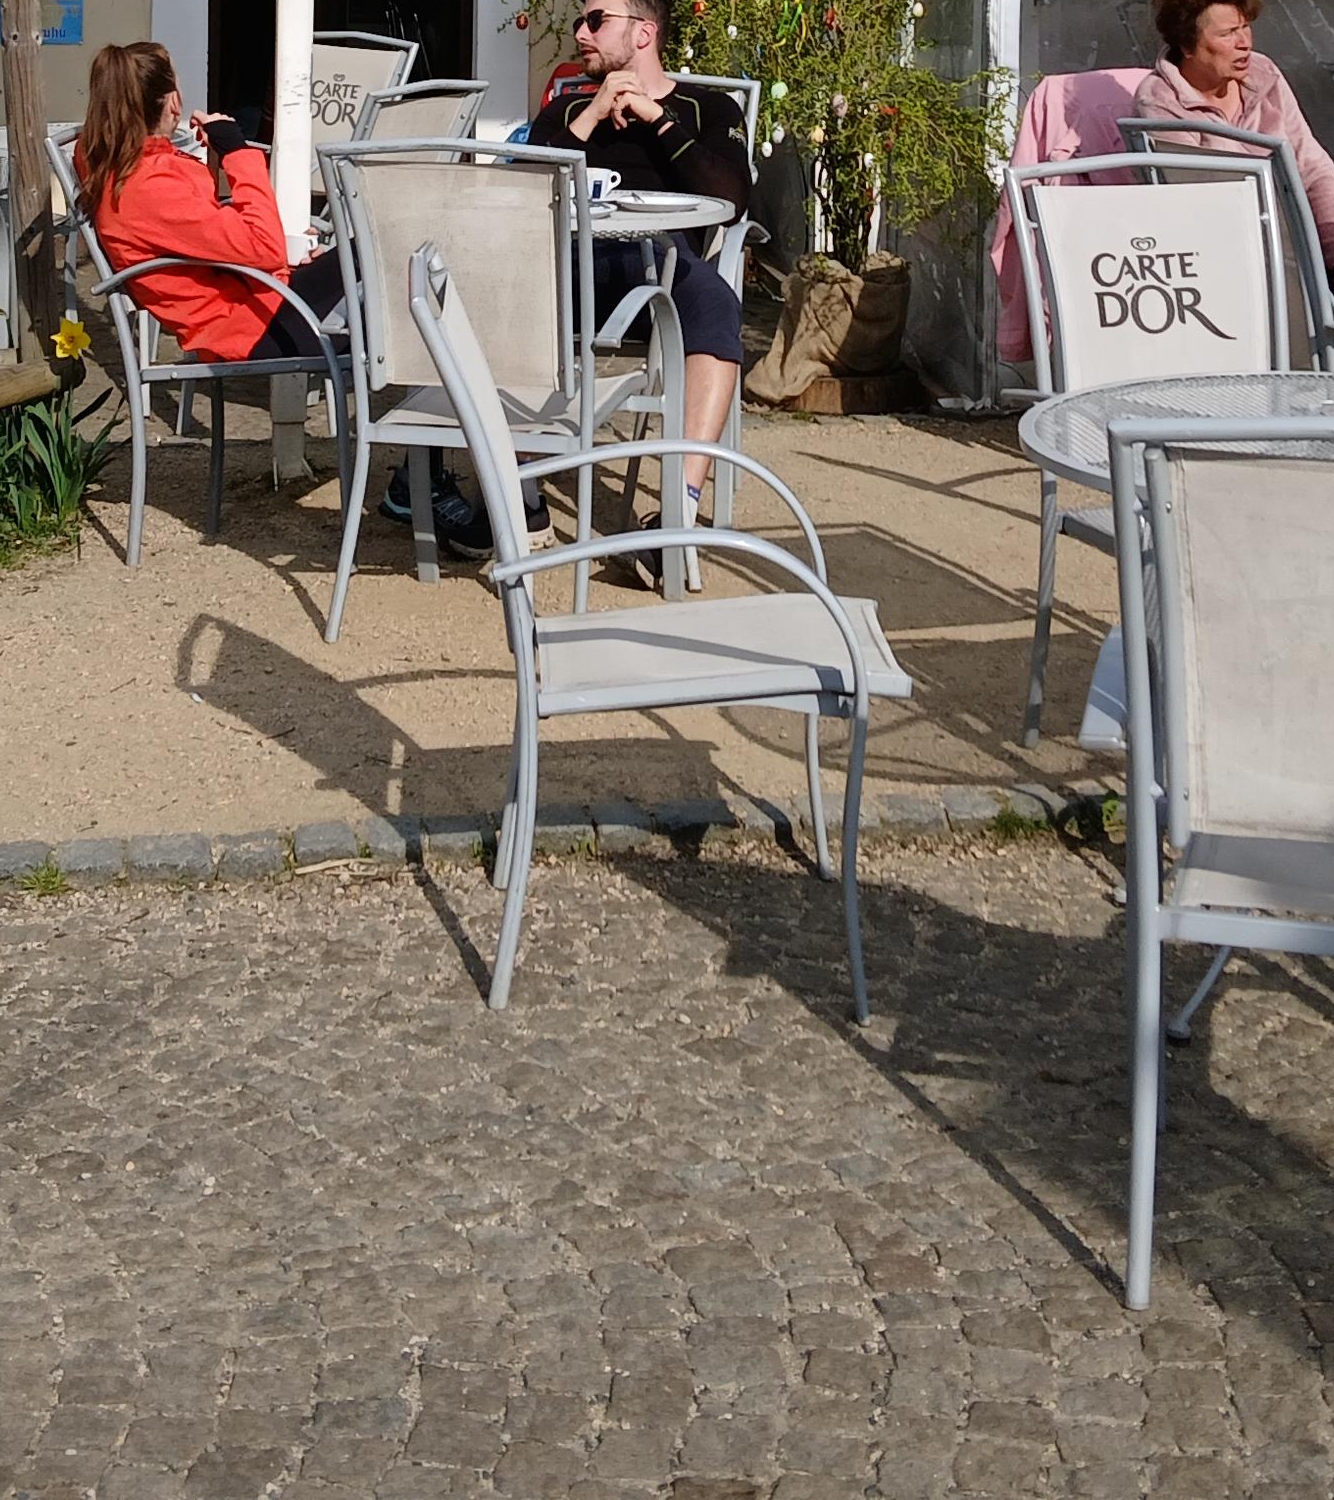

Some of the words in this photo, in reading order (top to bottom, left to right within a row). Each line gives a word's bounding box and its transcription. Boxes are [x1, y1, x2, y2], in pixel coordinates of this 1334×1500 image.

[311, 80, 361, 101] CARTE
[1091, 252, 1199, 287] CARTE
[1094, 283, 1237, 340] D'OR
